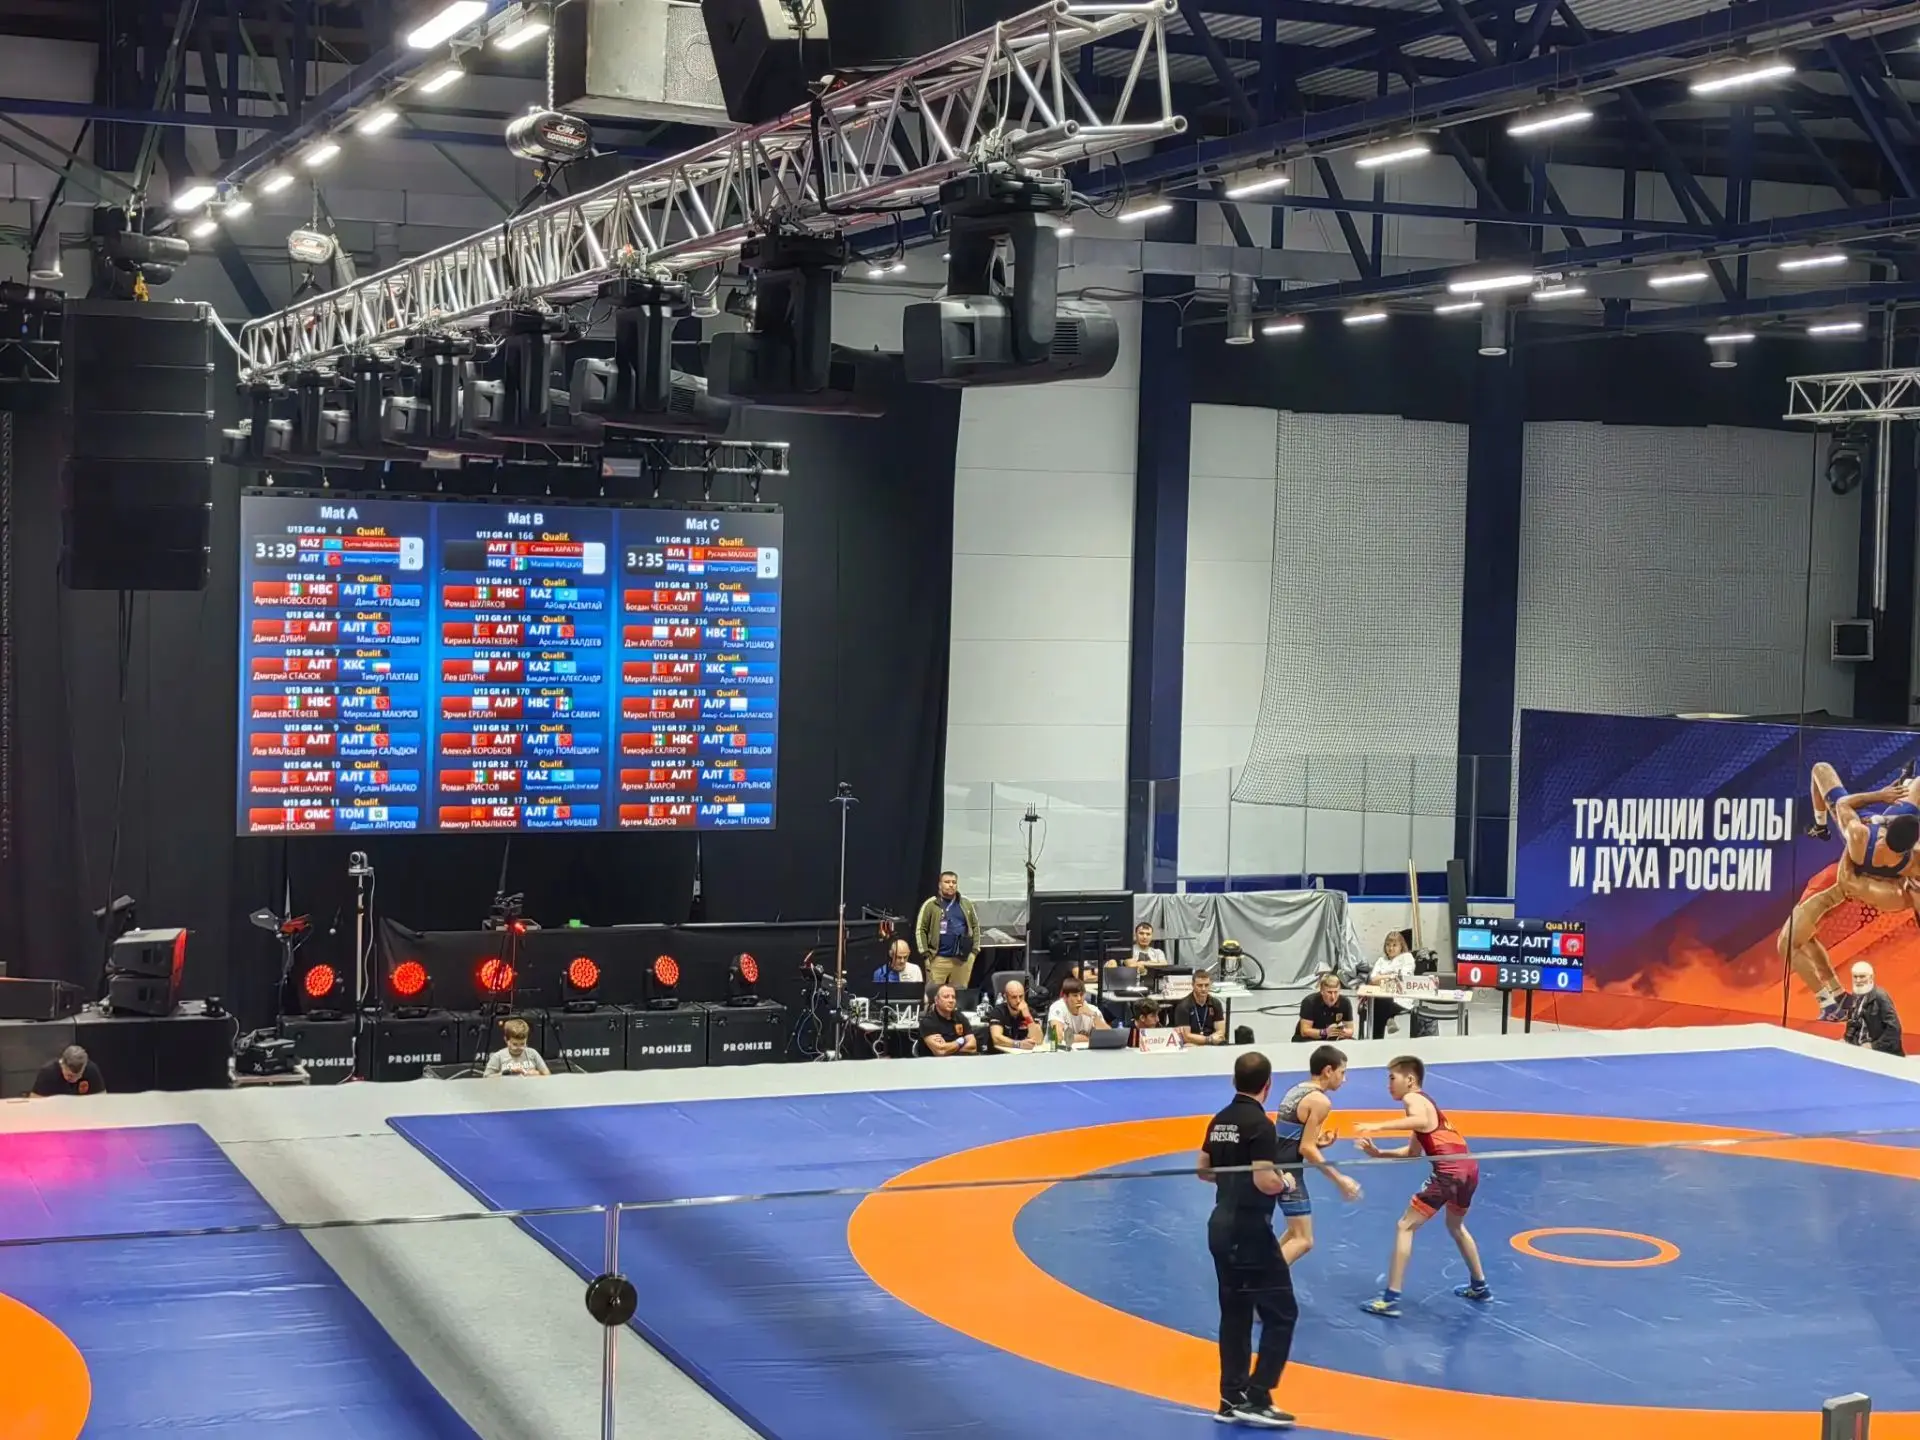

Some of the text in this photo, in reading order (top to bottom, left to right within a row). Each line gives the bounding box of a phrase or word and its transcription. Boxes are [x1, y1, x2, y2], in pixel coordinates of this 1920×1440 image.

[321, 506, 358, 520] Mat A
[508, 512, 543, 525] Mat B
[686, 518, 720, 530] Mat C
[256, 543, 296, 558] 3:39
[300, 554, 319, 562] АЛТ
[627, 553, 663, 566] 3:35
[667, 564, 685, 573] МРД
[309, 585, 333, 594] НВС
[343, 585, 367, 595] АЛТ
[497, 589, 519, 597] НВС
[531, 589, 551, 598] KAZ
[675, 592, 696, 602] АЛТ
[706, 593, 728, 604] МРД
[308, 622, 332, 631] АЛТ
[343, 622, 367, 632] АЛТ
[496, 625, 519, 634] АЛТ
[529, 625, 551, 634] АЛТ
[675, 628, 696, 637] АЛР
[706, 628, 727, 637] НВС
[308, 660, 331, 669] АЛТ
[343, 660, 365, 669] ХКС
[496, 662, 518, 671] АЛР
[529, 662, 550, 671] KAZ
[674, 664, 695, 673] АЛТ
[706, 664, 725, 673] ХКС
[308, 697, 331, 706] НВС
[342, 697, 366, 706] АЛТ
[495, 698, 518, 707] АЛР
[528, 699, 549, 707] НВС
[673, 699, 695, 708] АЛТ
[704, 699, 725, 708] АЛР
[307, 734, 331, 744] АЛТ
[341, 734, 365, 745] АЛТ
[494, 734, 517, 744] АЛТ
[527, 734, 549, 744] АЛТ
[672, 735, 693, 744] НВС
[703, 735, 724, 744] АЛТ
[306, 772, 330, 781] АЛТ
[340, 772, 364, 782] АЛТ
[494, 771, 515, 780] НВС
[527, 771, 548, 780] KAZ
[671, 770, 693, 779] АЛТ
[702, 771, 723, 779] АЛТ
[304, 810, 330, 819] ОМС
[340, 810, 364, 819] ТОМ
[494, 808, 514, 816] KGZ
[526, 807, 547, 816] АЛТ
[670, 806, 691, 814] АЛТ
[701, 806, 723, 814] АЛР
[1573, 797, 1793, 846] ТРАДИЦИИ СИЛЫ
[1569, 847, 1772, 894] И ДУХА РОССИИ
[1546, 922, 1583, 931] Qualif.
[1492, 935, 1518, 946] KAZ
[1523, 937, 1551, 948] АЛТ
[1524, 956, 1568, 965] ГОНЧАРОВ
[1470, 967, 1481, 983] 0
[1500, 968, 1540, 984] 3:39
[1558, 972, 1568, 988] 0
[1406, 981, 1429, 990] ВРАЧ
